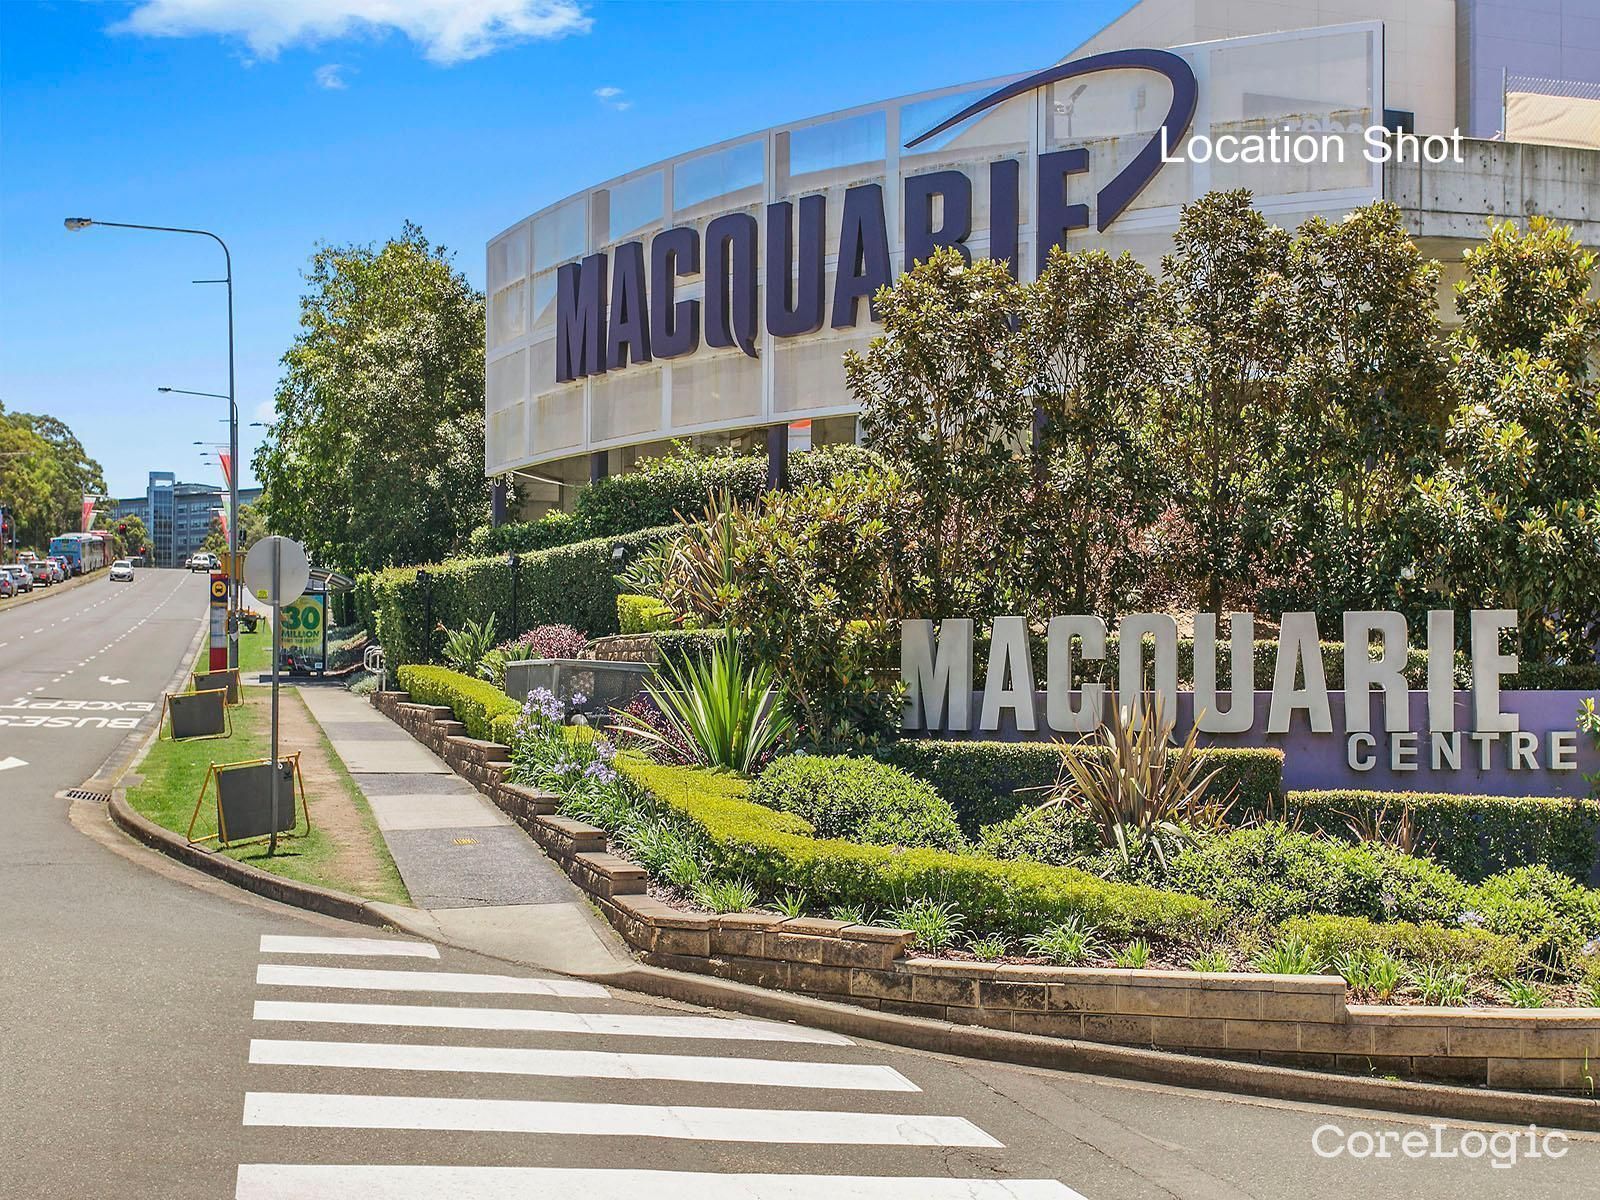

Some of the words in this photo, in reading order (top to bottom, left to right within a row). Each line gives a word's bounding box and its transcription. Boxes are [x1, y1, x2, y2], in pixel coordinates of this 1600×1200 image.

[281, 606, 320, 630] 30
[281, 630, 320, 638] MILLION
[900, 610, 1520, 746] MACQUARIE
[1347, 731, 1579, 771] CENTRE
